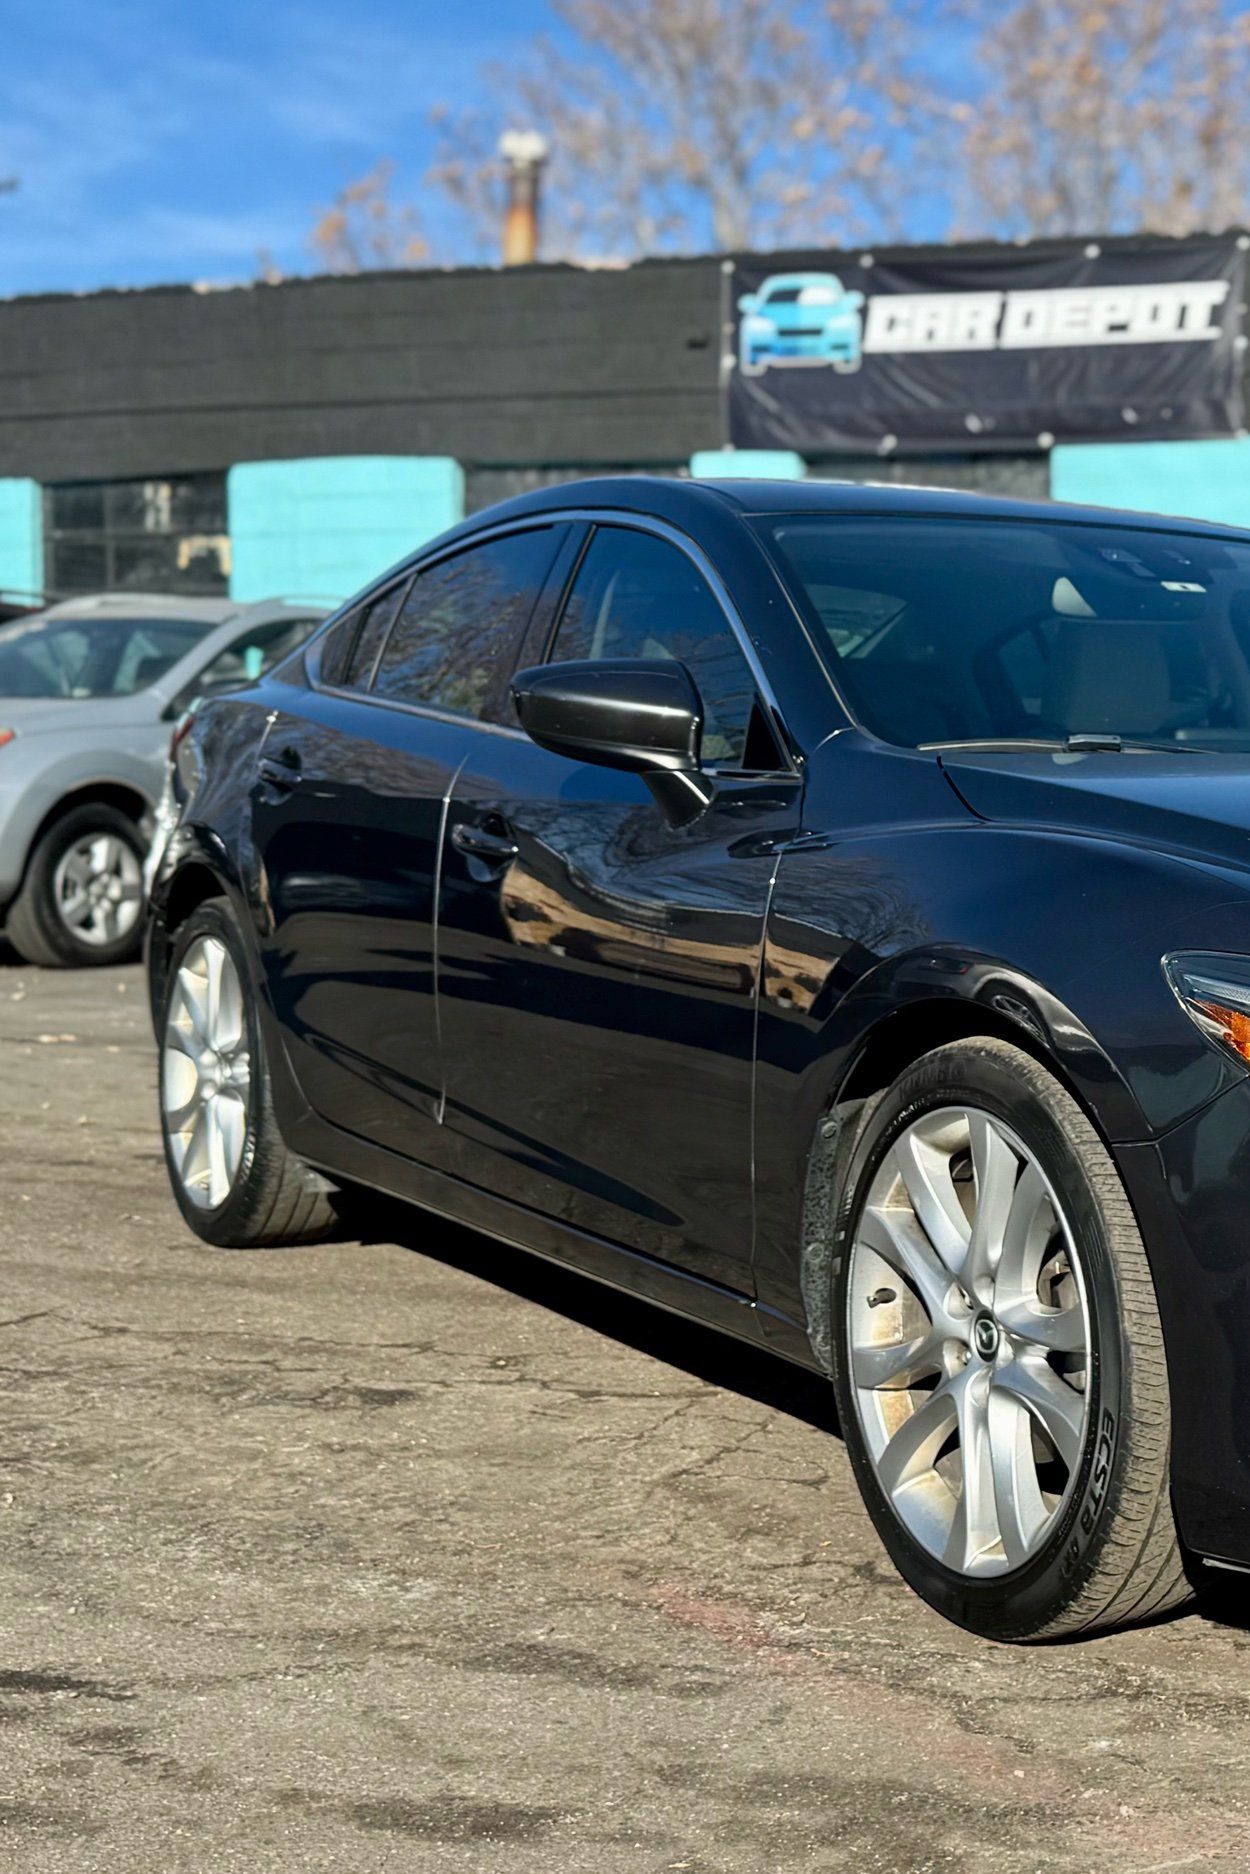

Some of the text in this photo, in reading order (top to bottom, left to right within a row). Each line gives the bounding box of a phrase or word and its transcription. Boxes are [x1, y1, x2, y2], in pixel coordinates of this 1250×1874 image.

[865, 280, 1229, 353] CAR DEPOT
[1079, 1406, 1114, 1536] ECSTA
